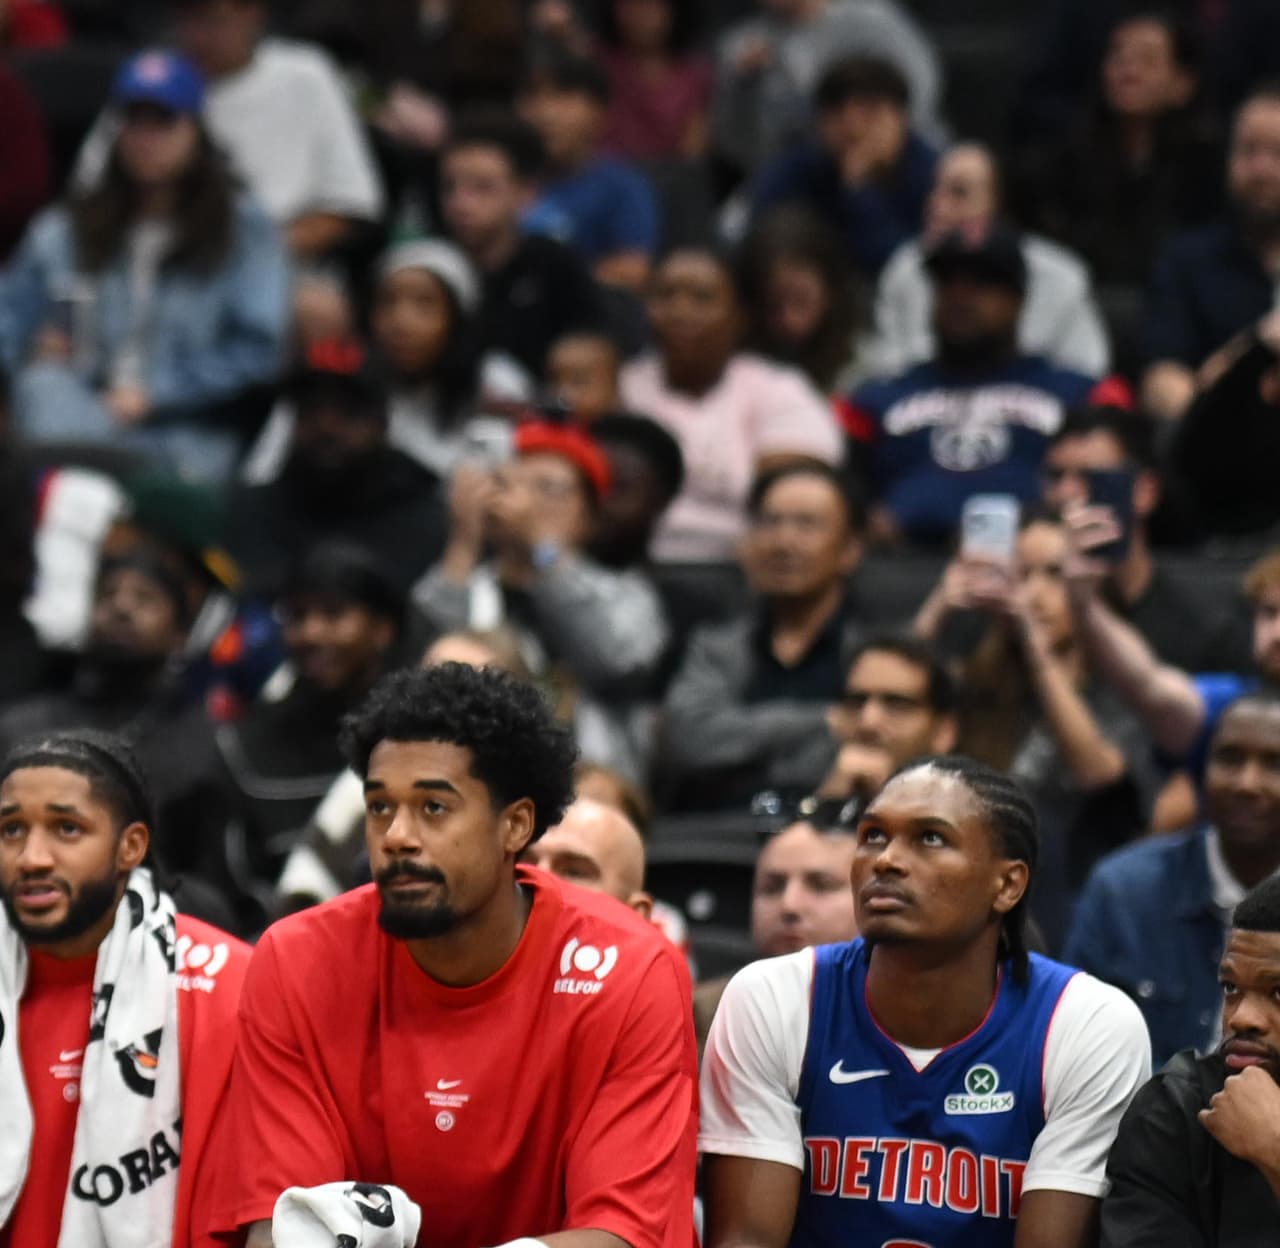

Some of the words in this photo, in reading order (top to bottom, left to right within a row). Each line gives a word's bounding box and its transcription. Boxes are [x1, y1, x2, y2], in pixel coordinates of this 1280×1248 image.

[553, 978, 604, 994] BELFOR
[947, 1095, 1012, 1111] StockX
[804, 1136, 1028, 1219] DETROIT
